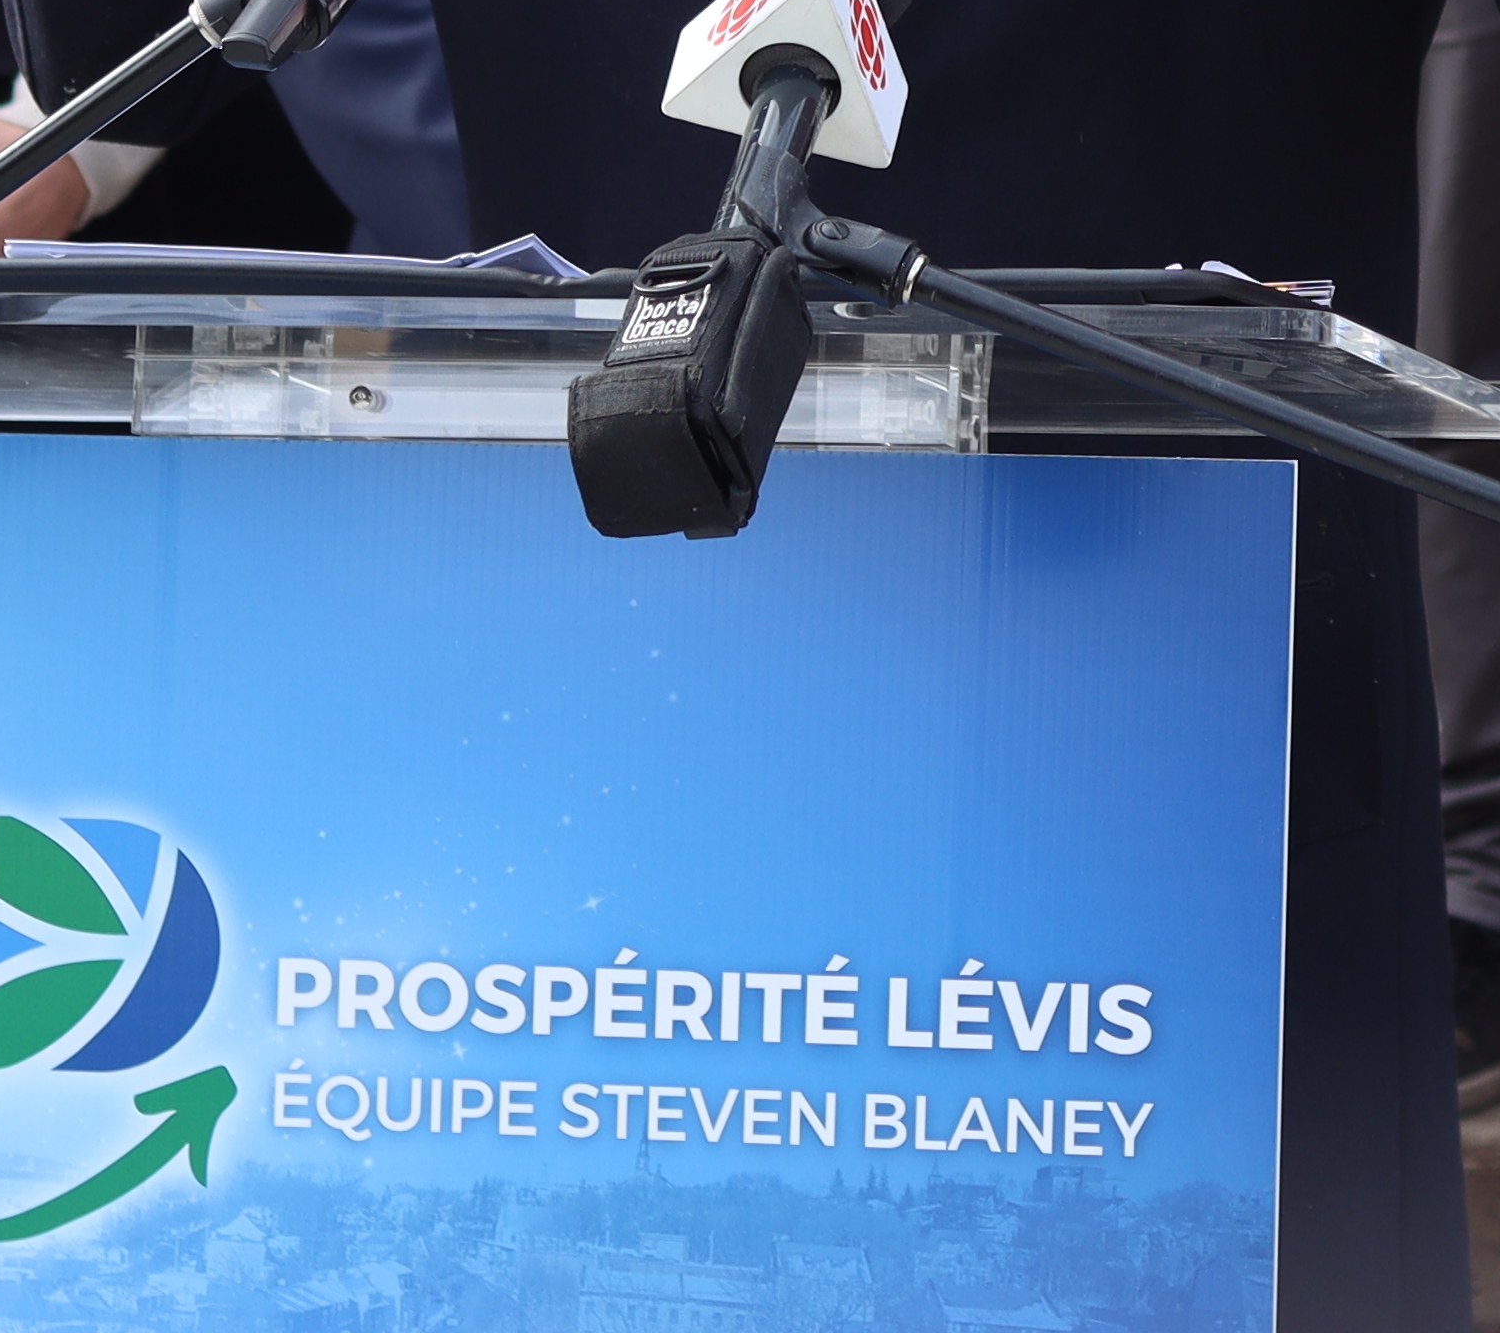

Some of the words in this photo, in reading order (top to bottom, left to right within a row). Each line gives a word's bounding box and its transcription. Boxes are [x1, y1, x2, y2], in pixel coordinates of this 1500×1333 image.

[628, 316, 690, 340] brace
[276, 946, 860, 1047] PROSPÉRITÉ
[887, 957, 1154, 1056] LÉVIS
[273, 1057, 538, 1142] ÉQUIPE
[558, 1082, 837, 1148] STEVEN
[863, 1093, 1155, 1158] BLANEY
